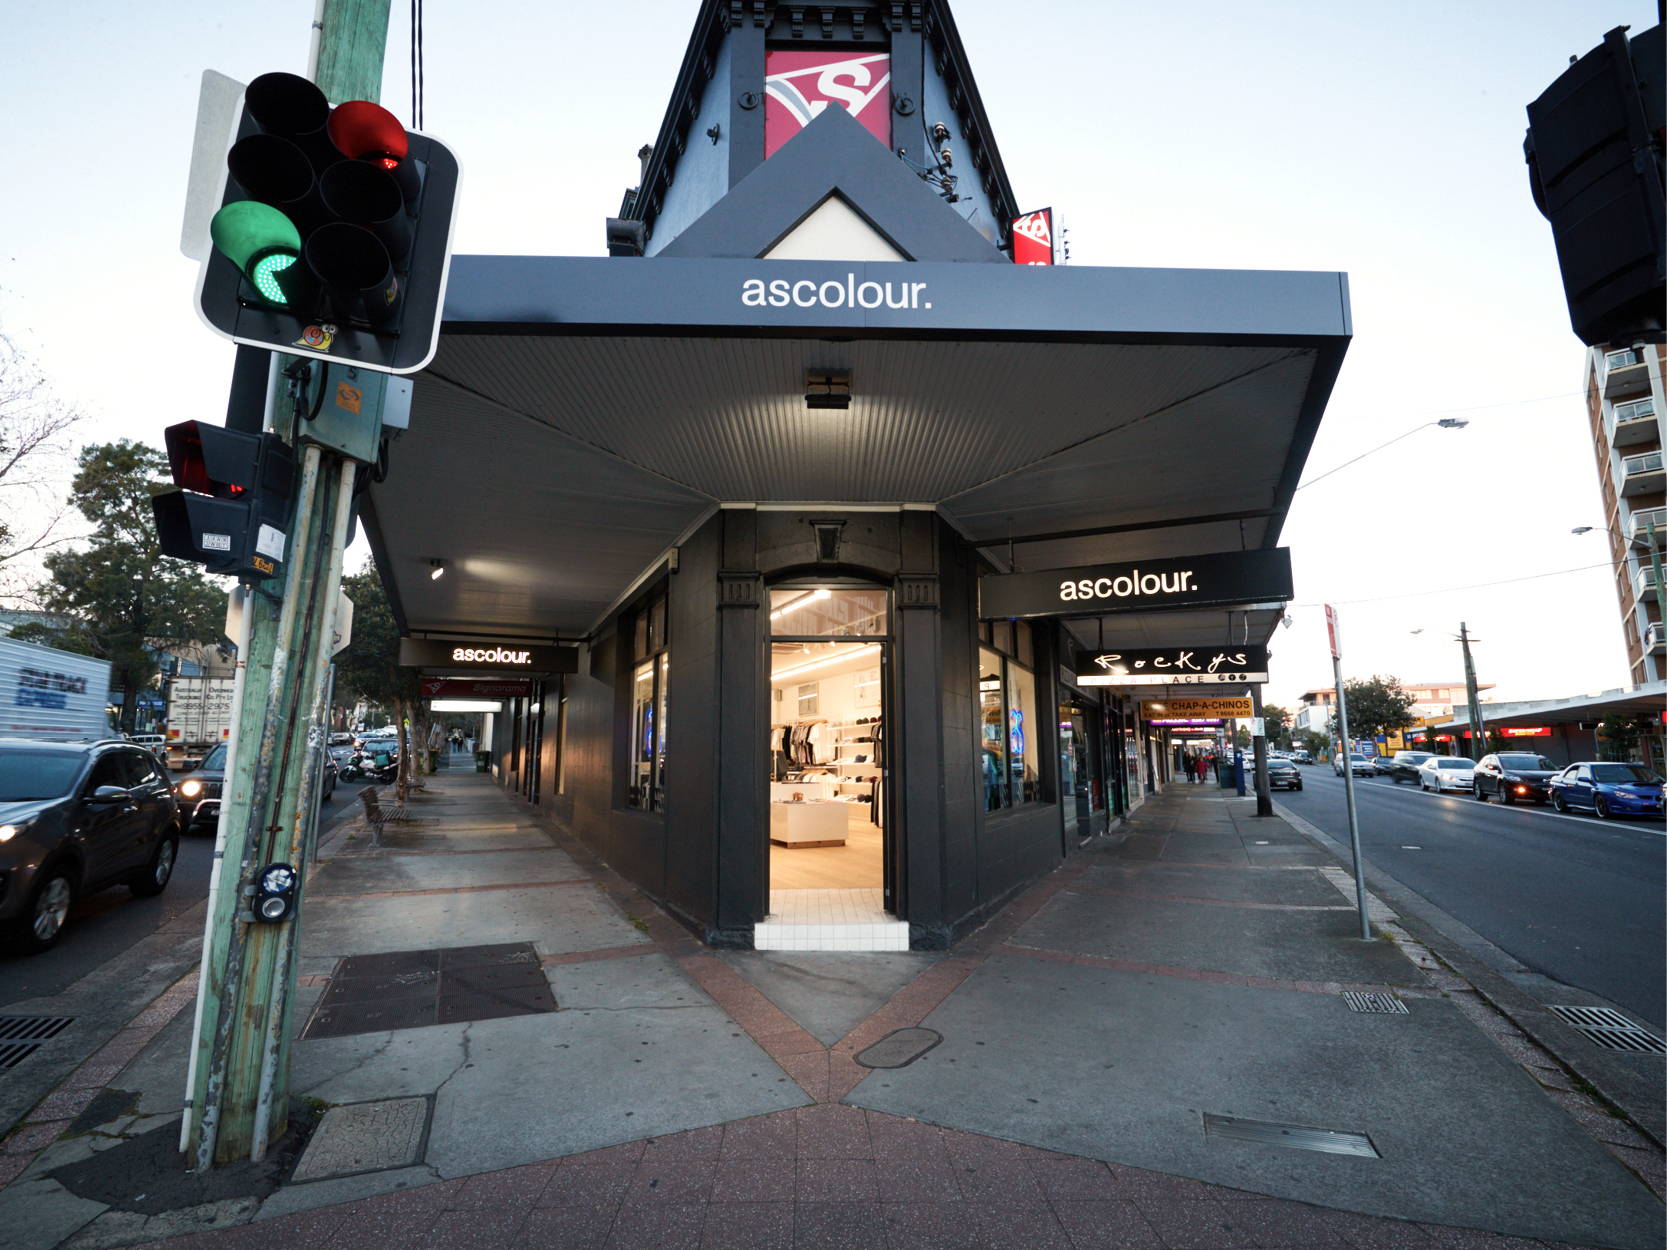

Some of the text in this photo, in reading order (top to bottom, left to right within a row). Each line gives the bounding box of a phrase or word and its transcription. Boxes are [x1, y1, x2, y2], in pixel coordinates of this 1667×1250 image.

[742, 273, 932, 310] ascolour.
[1060, 570, 1198, 601] ascolour.
[452, 646, 532, 664] ascolour.
